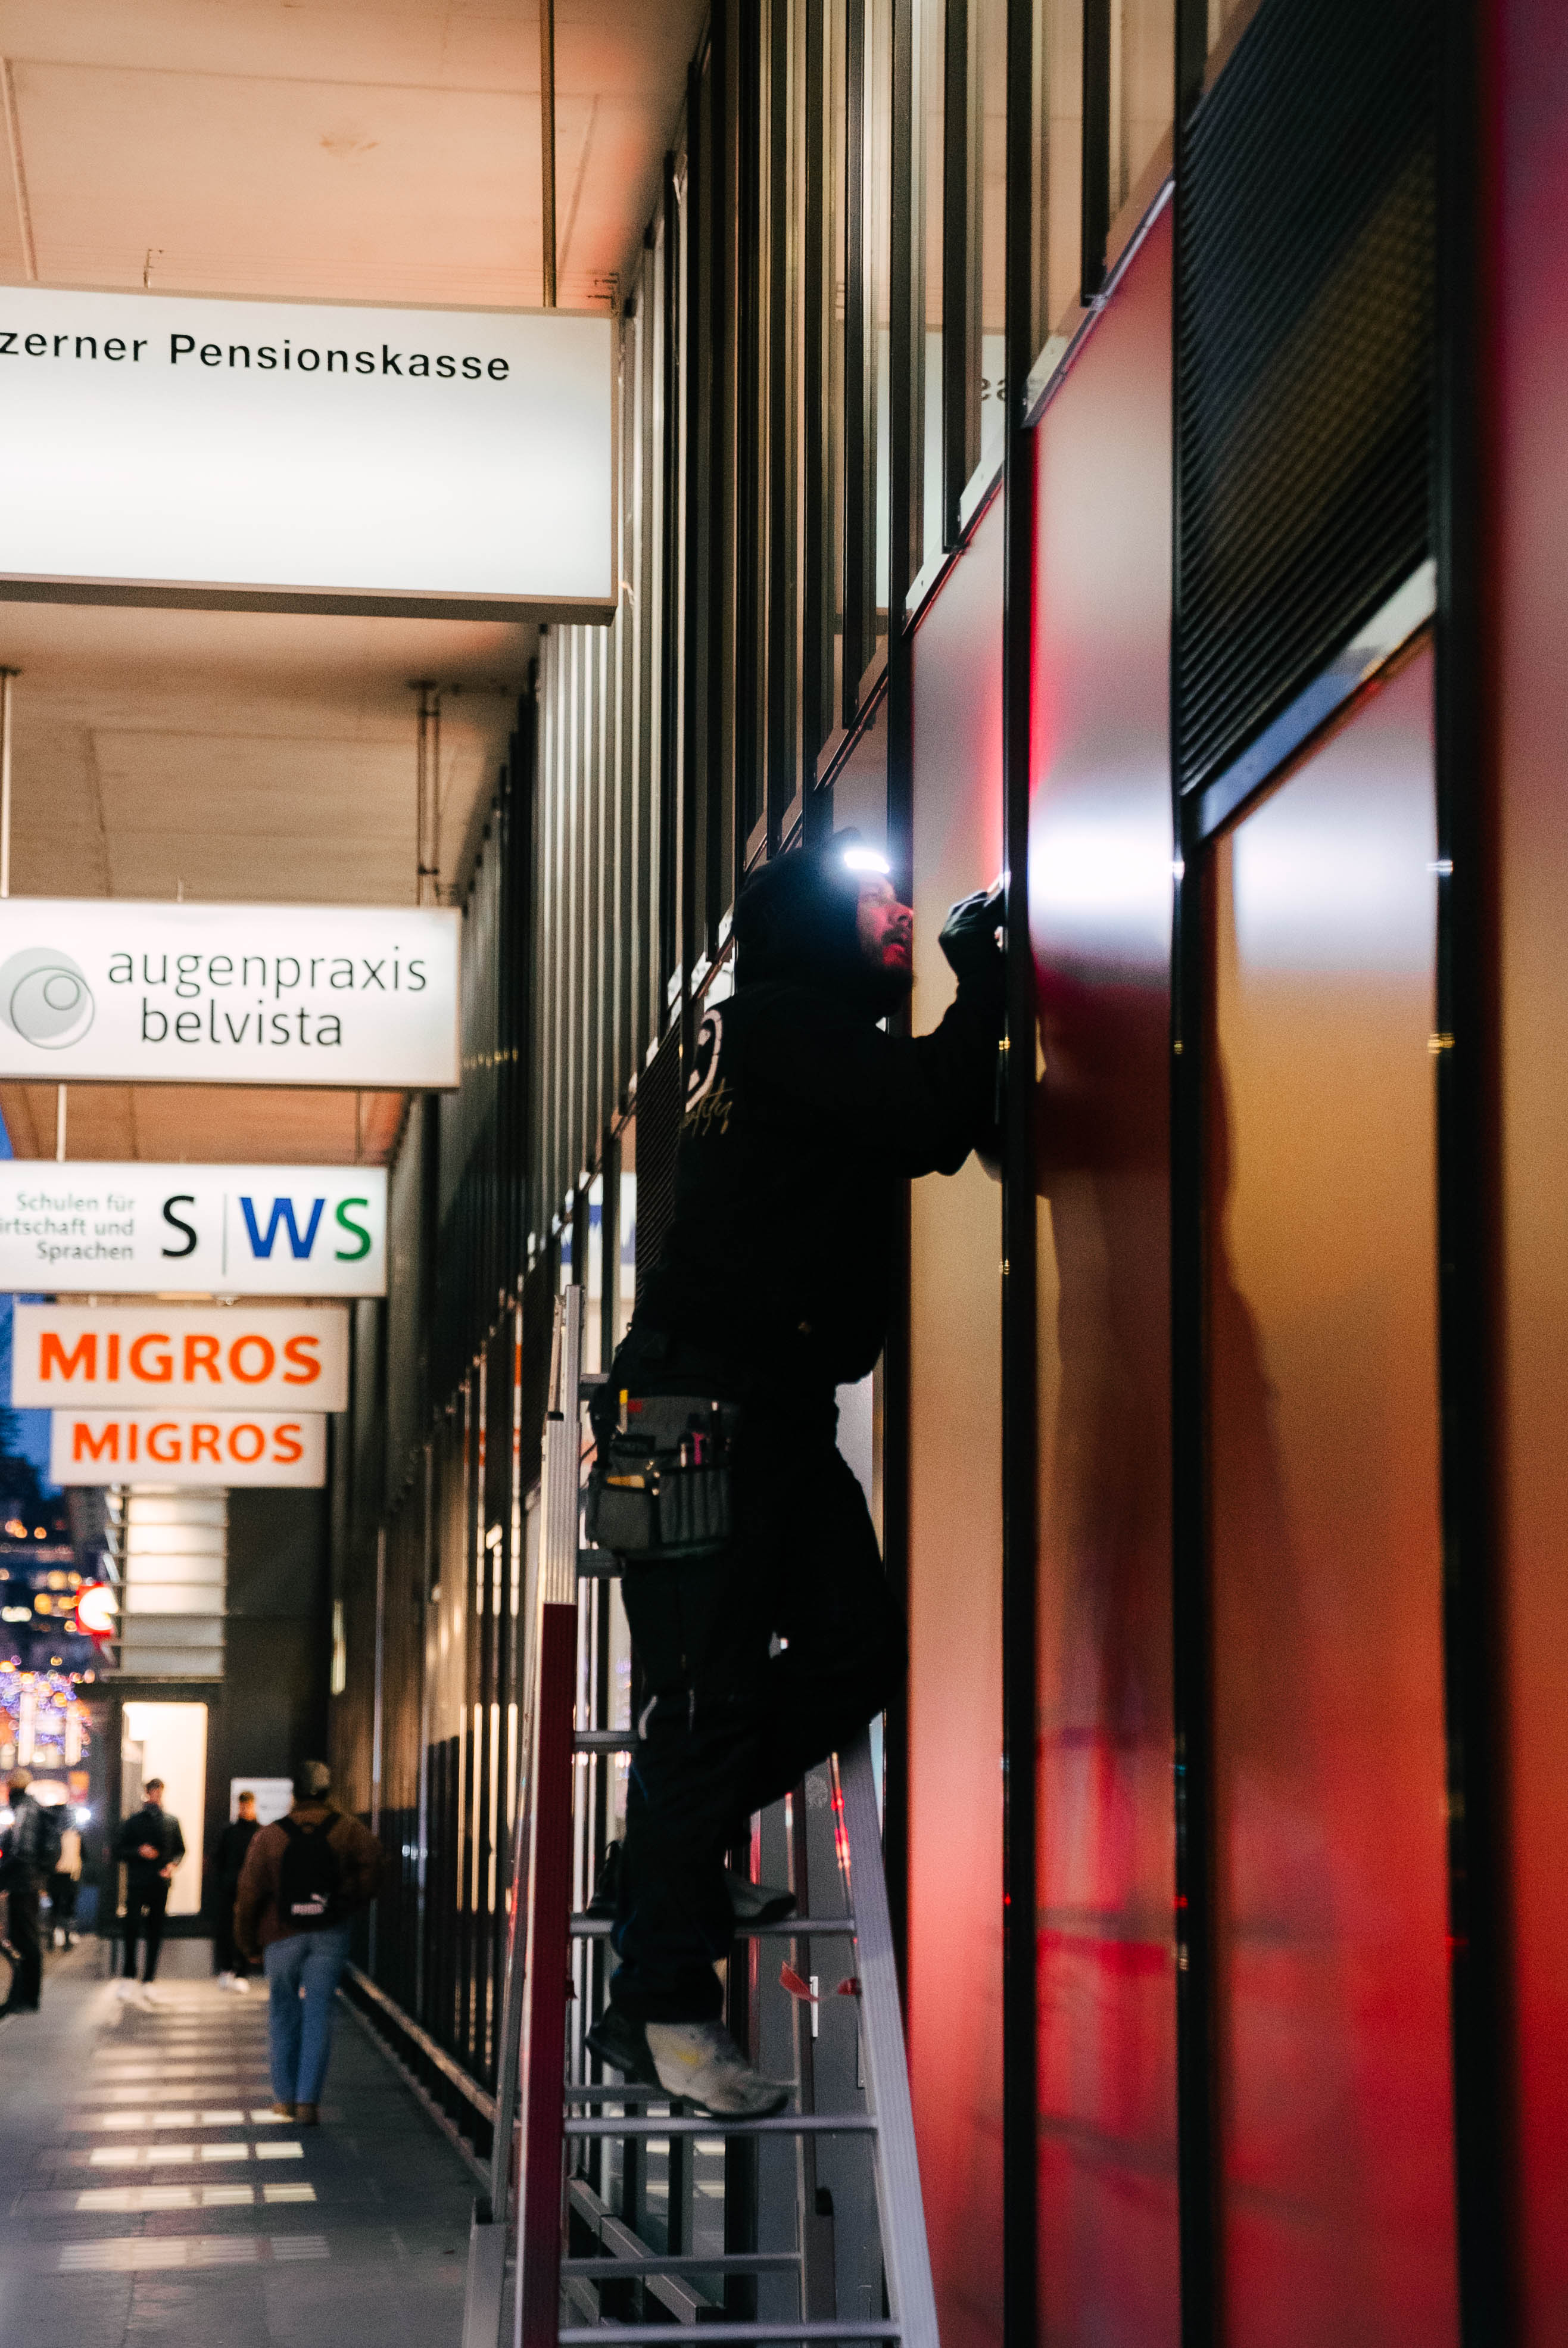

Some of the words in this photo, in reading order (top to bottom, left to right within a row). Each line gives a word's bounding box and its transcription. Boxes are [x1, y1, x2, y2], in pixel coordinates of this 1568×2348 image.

[0, 332, 148, 362] zerner
[170, 334, 510, 381] Pensionskasse
[108, 946, 427, 999] augenpraxis
[142, 997, 342, 1047] belvista
[17, 1192, 98, 1212] Schulen
[107, 1193, 135, 1212] für
[95, 1219, 134, 1236] und
[37, 1241, 133, 1263] Sprachen
[39, 1332, 323, 1386] MIGROS
[72, 1422, 304, 1465] MIGROS
